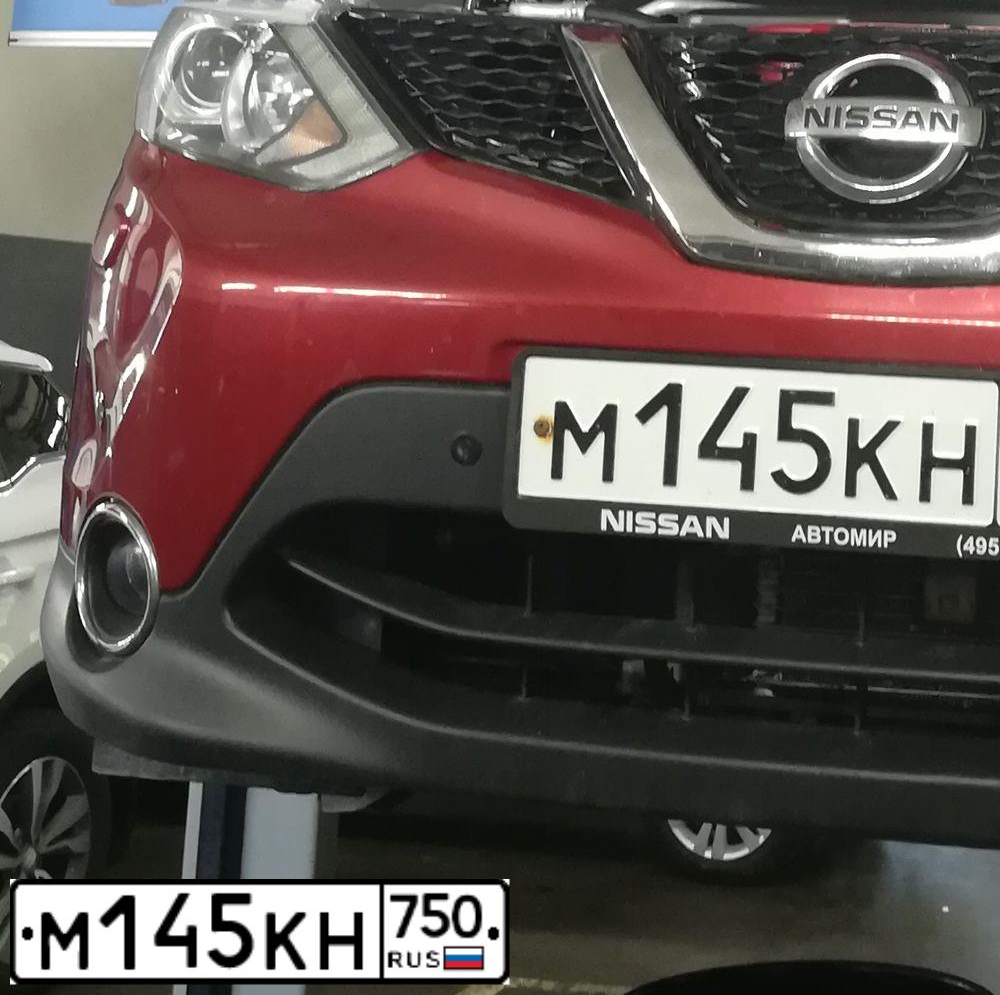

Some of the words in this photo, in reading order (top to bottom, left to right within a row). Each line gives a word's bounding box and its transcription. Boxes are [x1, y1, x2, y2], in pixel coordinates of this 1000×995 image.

[803, 105, 960, 133] NISSAN
[600, 508, 730, 540] NISSAN
[791, 524, 897, 549] АВТОМИР
